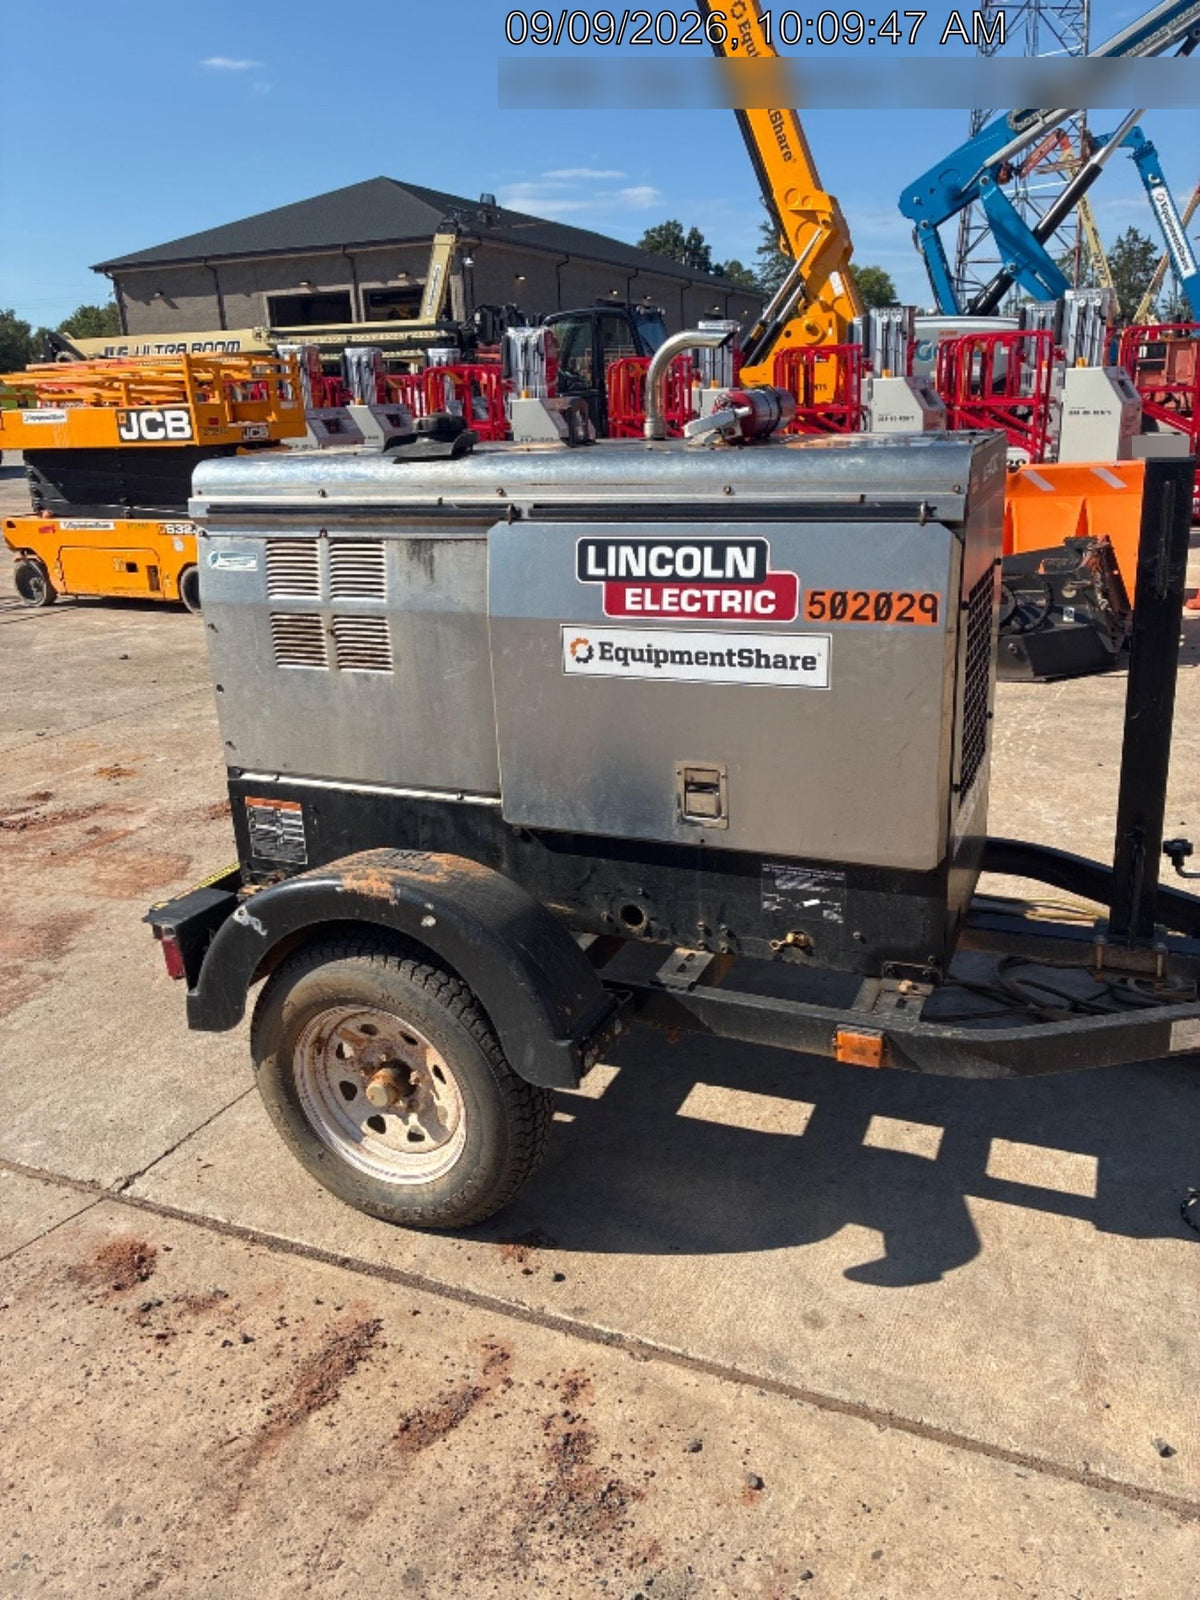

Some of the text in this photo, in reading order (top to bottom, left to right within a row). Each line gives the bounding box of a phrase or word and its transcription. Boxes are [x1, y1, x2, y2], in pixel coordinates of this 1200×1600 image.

[120, 410, 192, 440] JCB
[242, 427, 270, 440] JCB
[587, 545, 757, 578] LINCOLN
[624, 588, 776, 614] ELECTRIC
[808, 591, 939, 623] 502029
[597, 641, 818, 672] EquipmentShare
